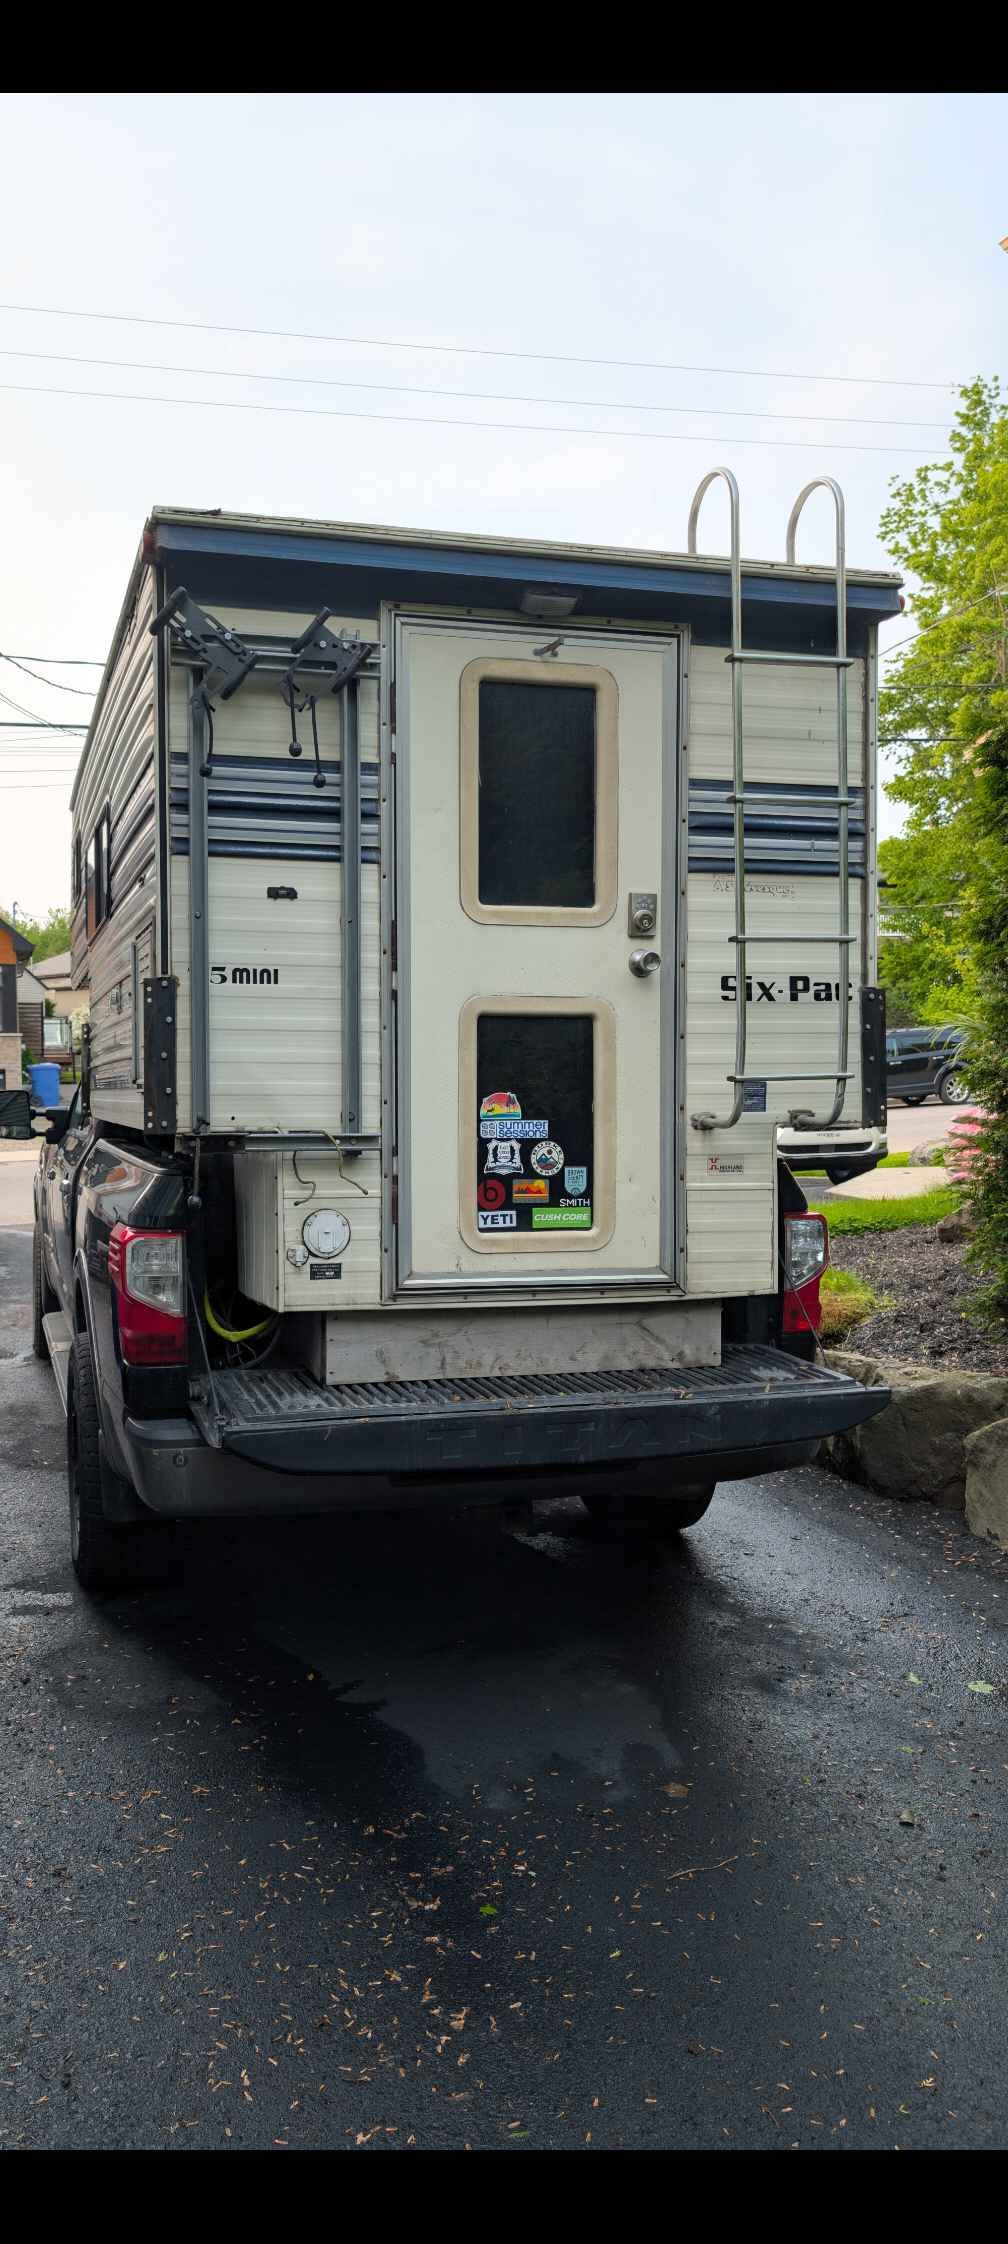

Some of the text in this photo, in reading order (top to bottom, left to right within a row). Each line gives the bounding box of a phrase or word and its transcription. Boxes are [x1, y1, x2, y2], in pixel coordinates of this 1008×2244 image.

[498, 1121, 548, 1130] summer
[498, 1129, 548, 1138] sessions
[559, 1198, 591, 1207] SMITH
[480, 1213, 514, 1226] YETI
